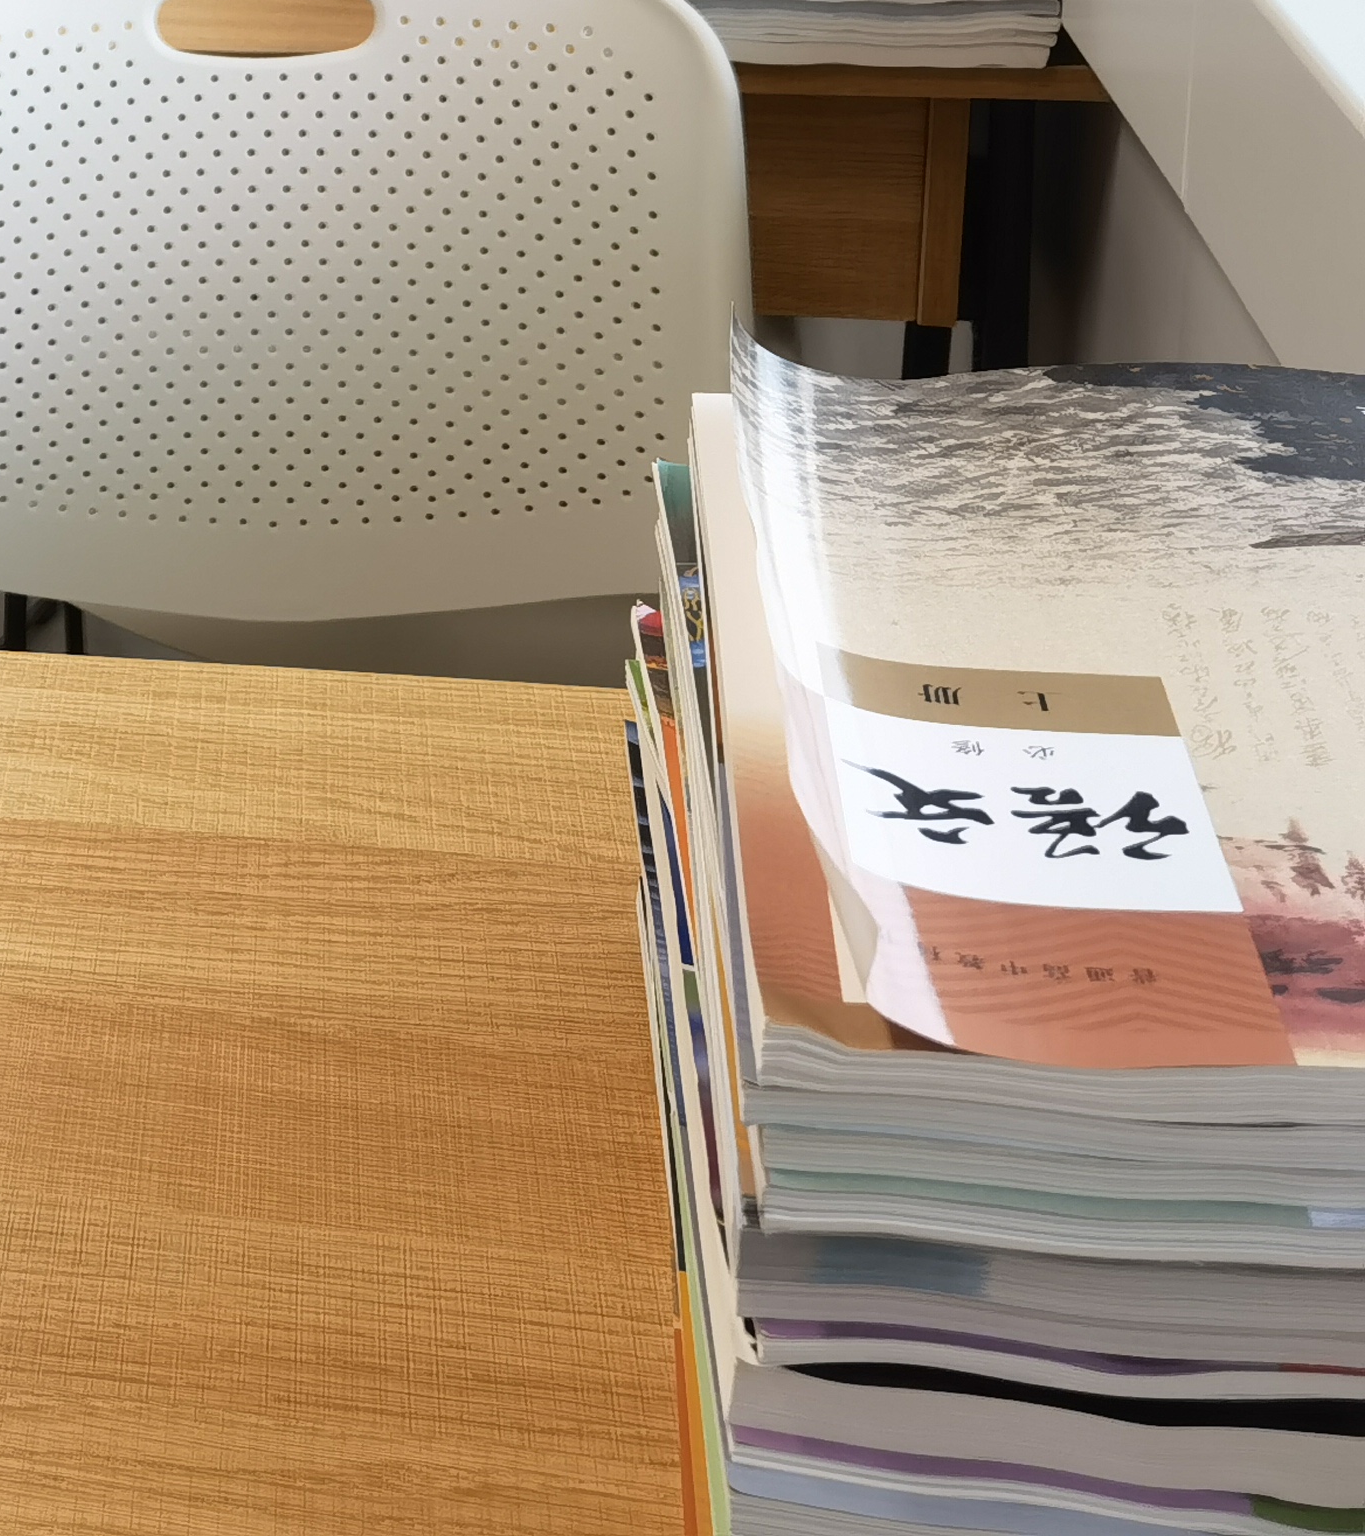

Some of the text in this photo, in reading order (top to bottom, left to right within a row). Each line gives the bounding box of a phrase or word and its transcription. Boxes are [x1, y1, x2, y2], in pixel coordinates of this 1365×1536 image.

[917, 683, 1052, 714] 上册
[949, 738, 1057, 761] 必修
[840, 758, 1191, 862] 语文
